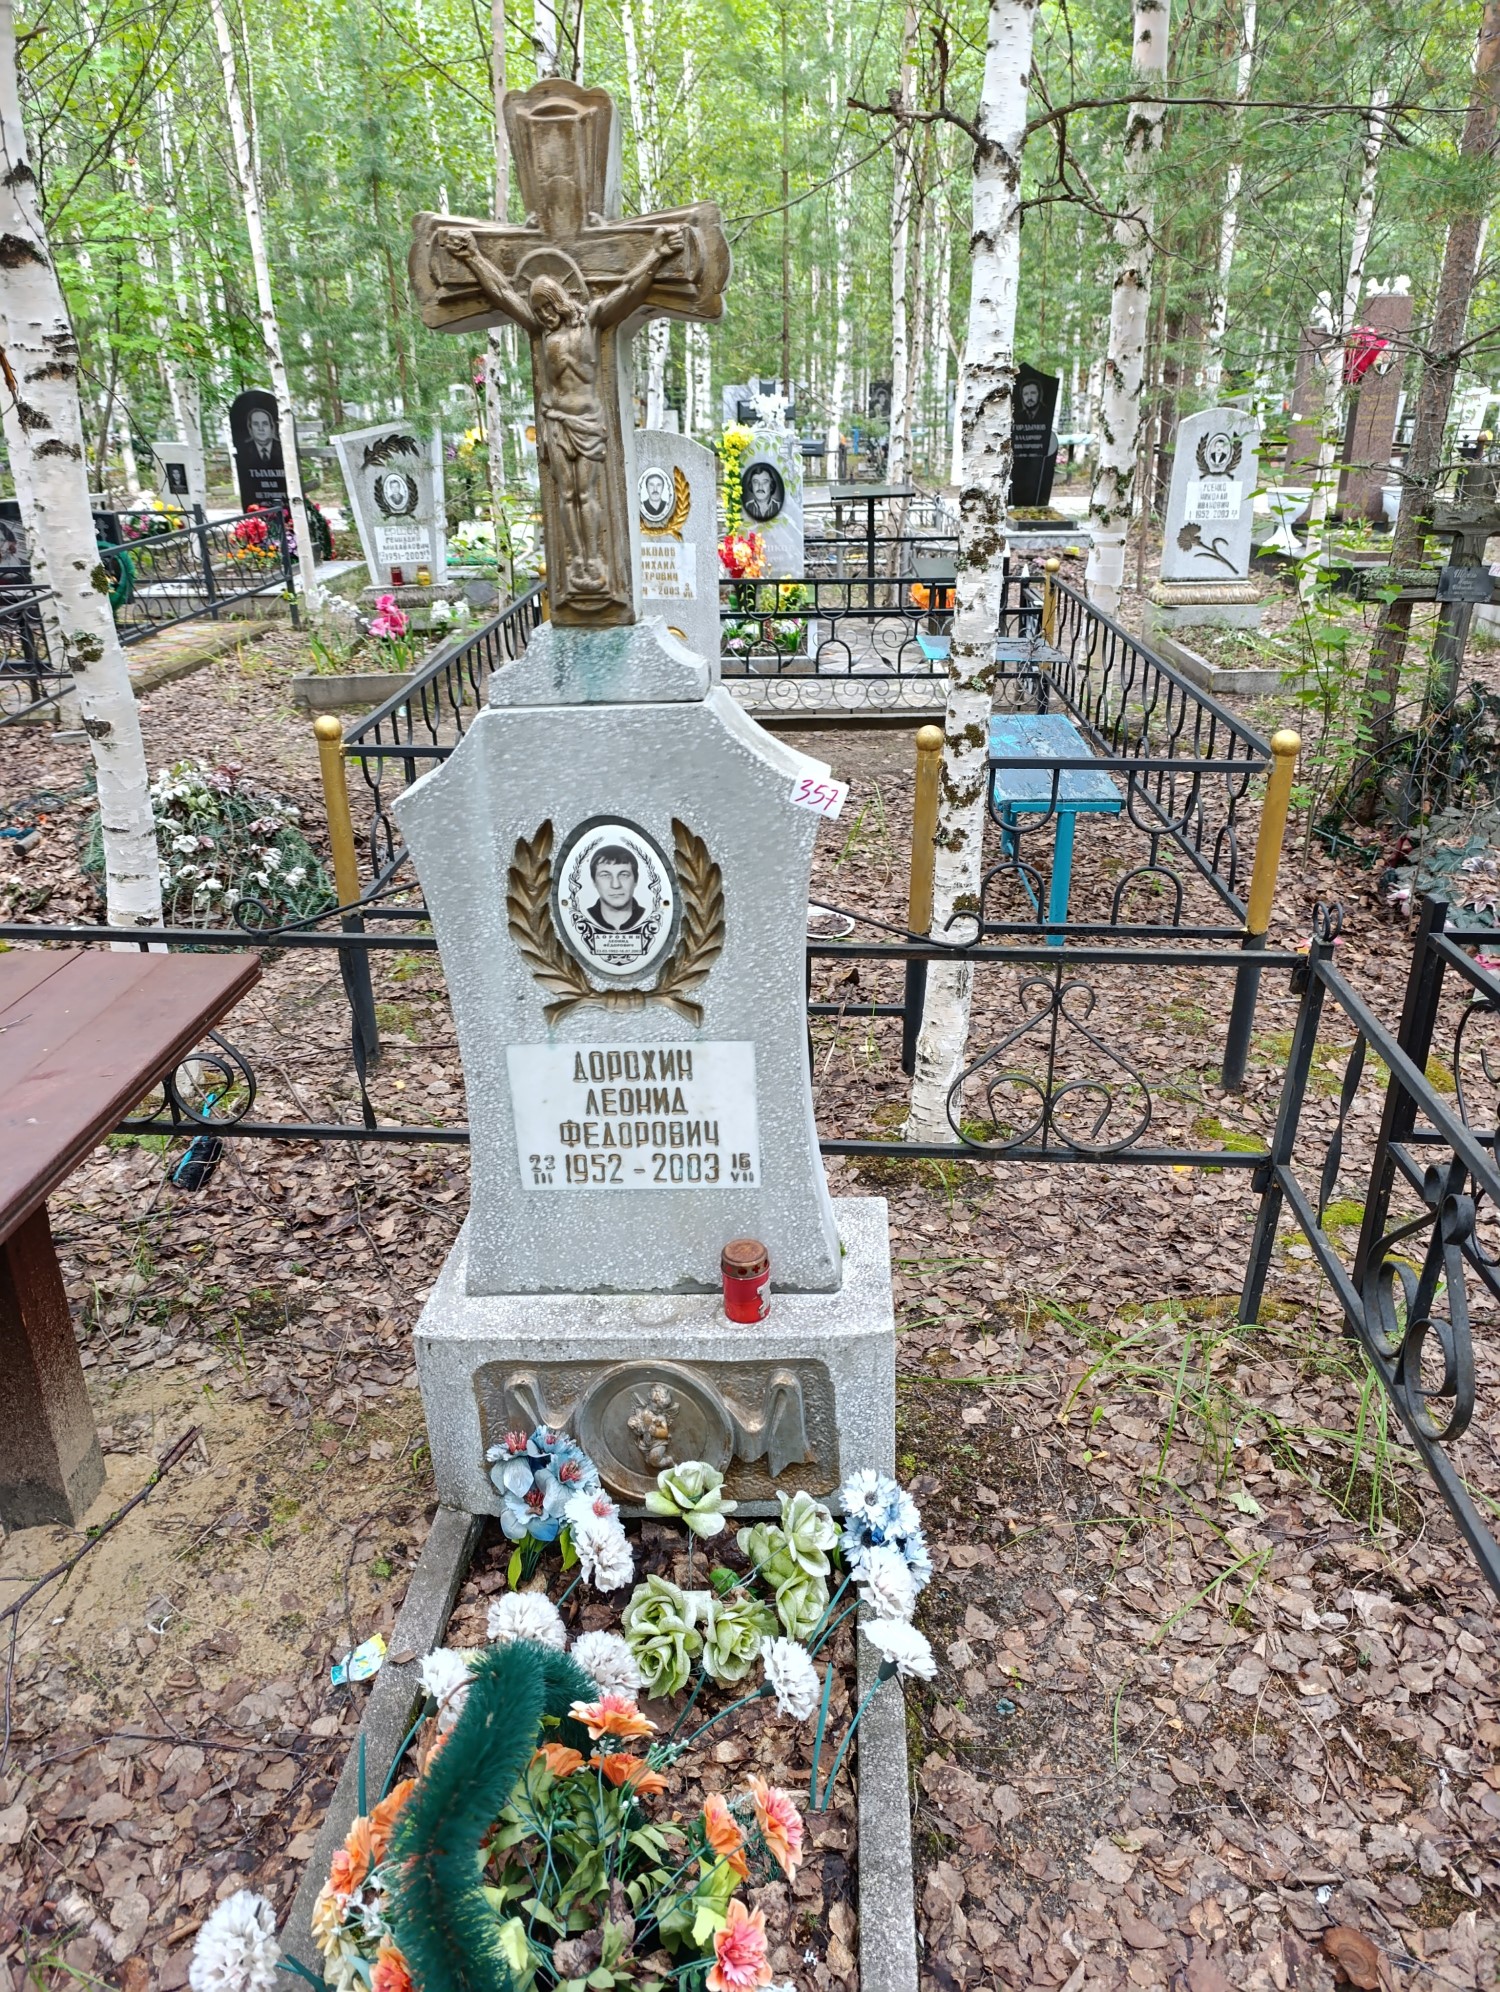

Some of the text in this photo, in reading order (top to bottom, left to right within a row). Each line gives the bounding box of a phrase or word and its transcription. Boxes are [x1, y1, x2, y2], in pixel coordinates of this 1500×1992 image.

[641, 546, 676, 557] ОКОЛОВ
[794, 779, 840, 811] 357
[572, 1049, 694, 1083] ДОРОХИН
[585, 1086, 689, 1117] ЛЕОНИД
[559, 1119, 720, 1149] ФЕДОРОВИЧ
[529, 1154, 556, 1173] 23
[731, 1152, 752, 1171] 16
[730, 1171, 755, 1184] VII
